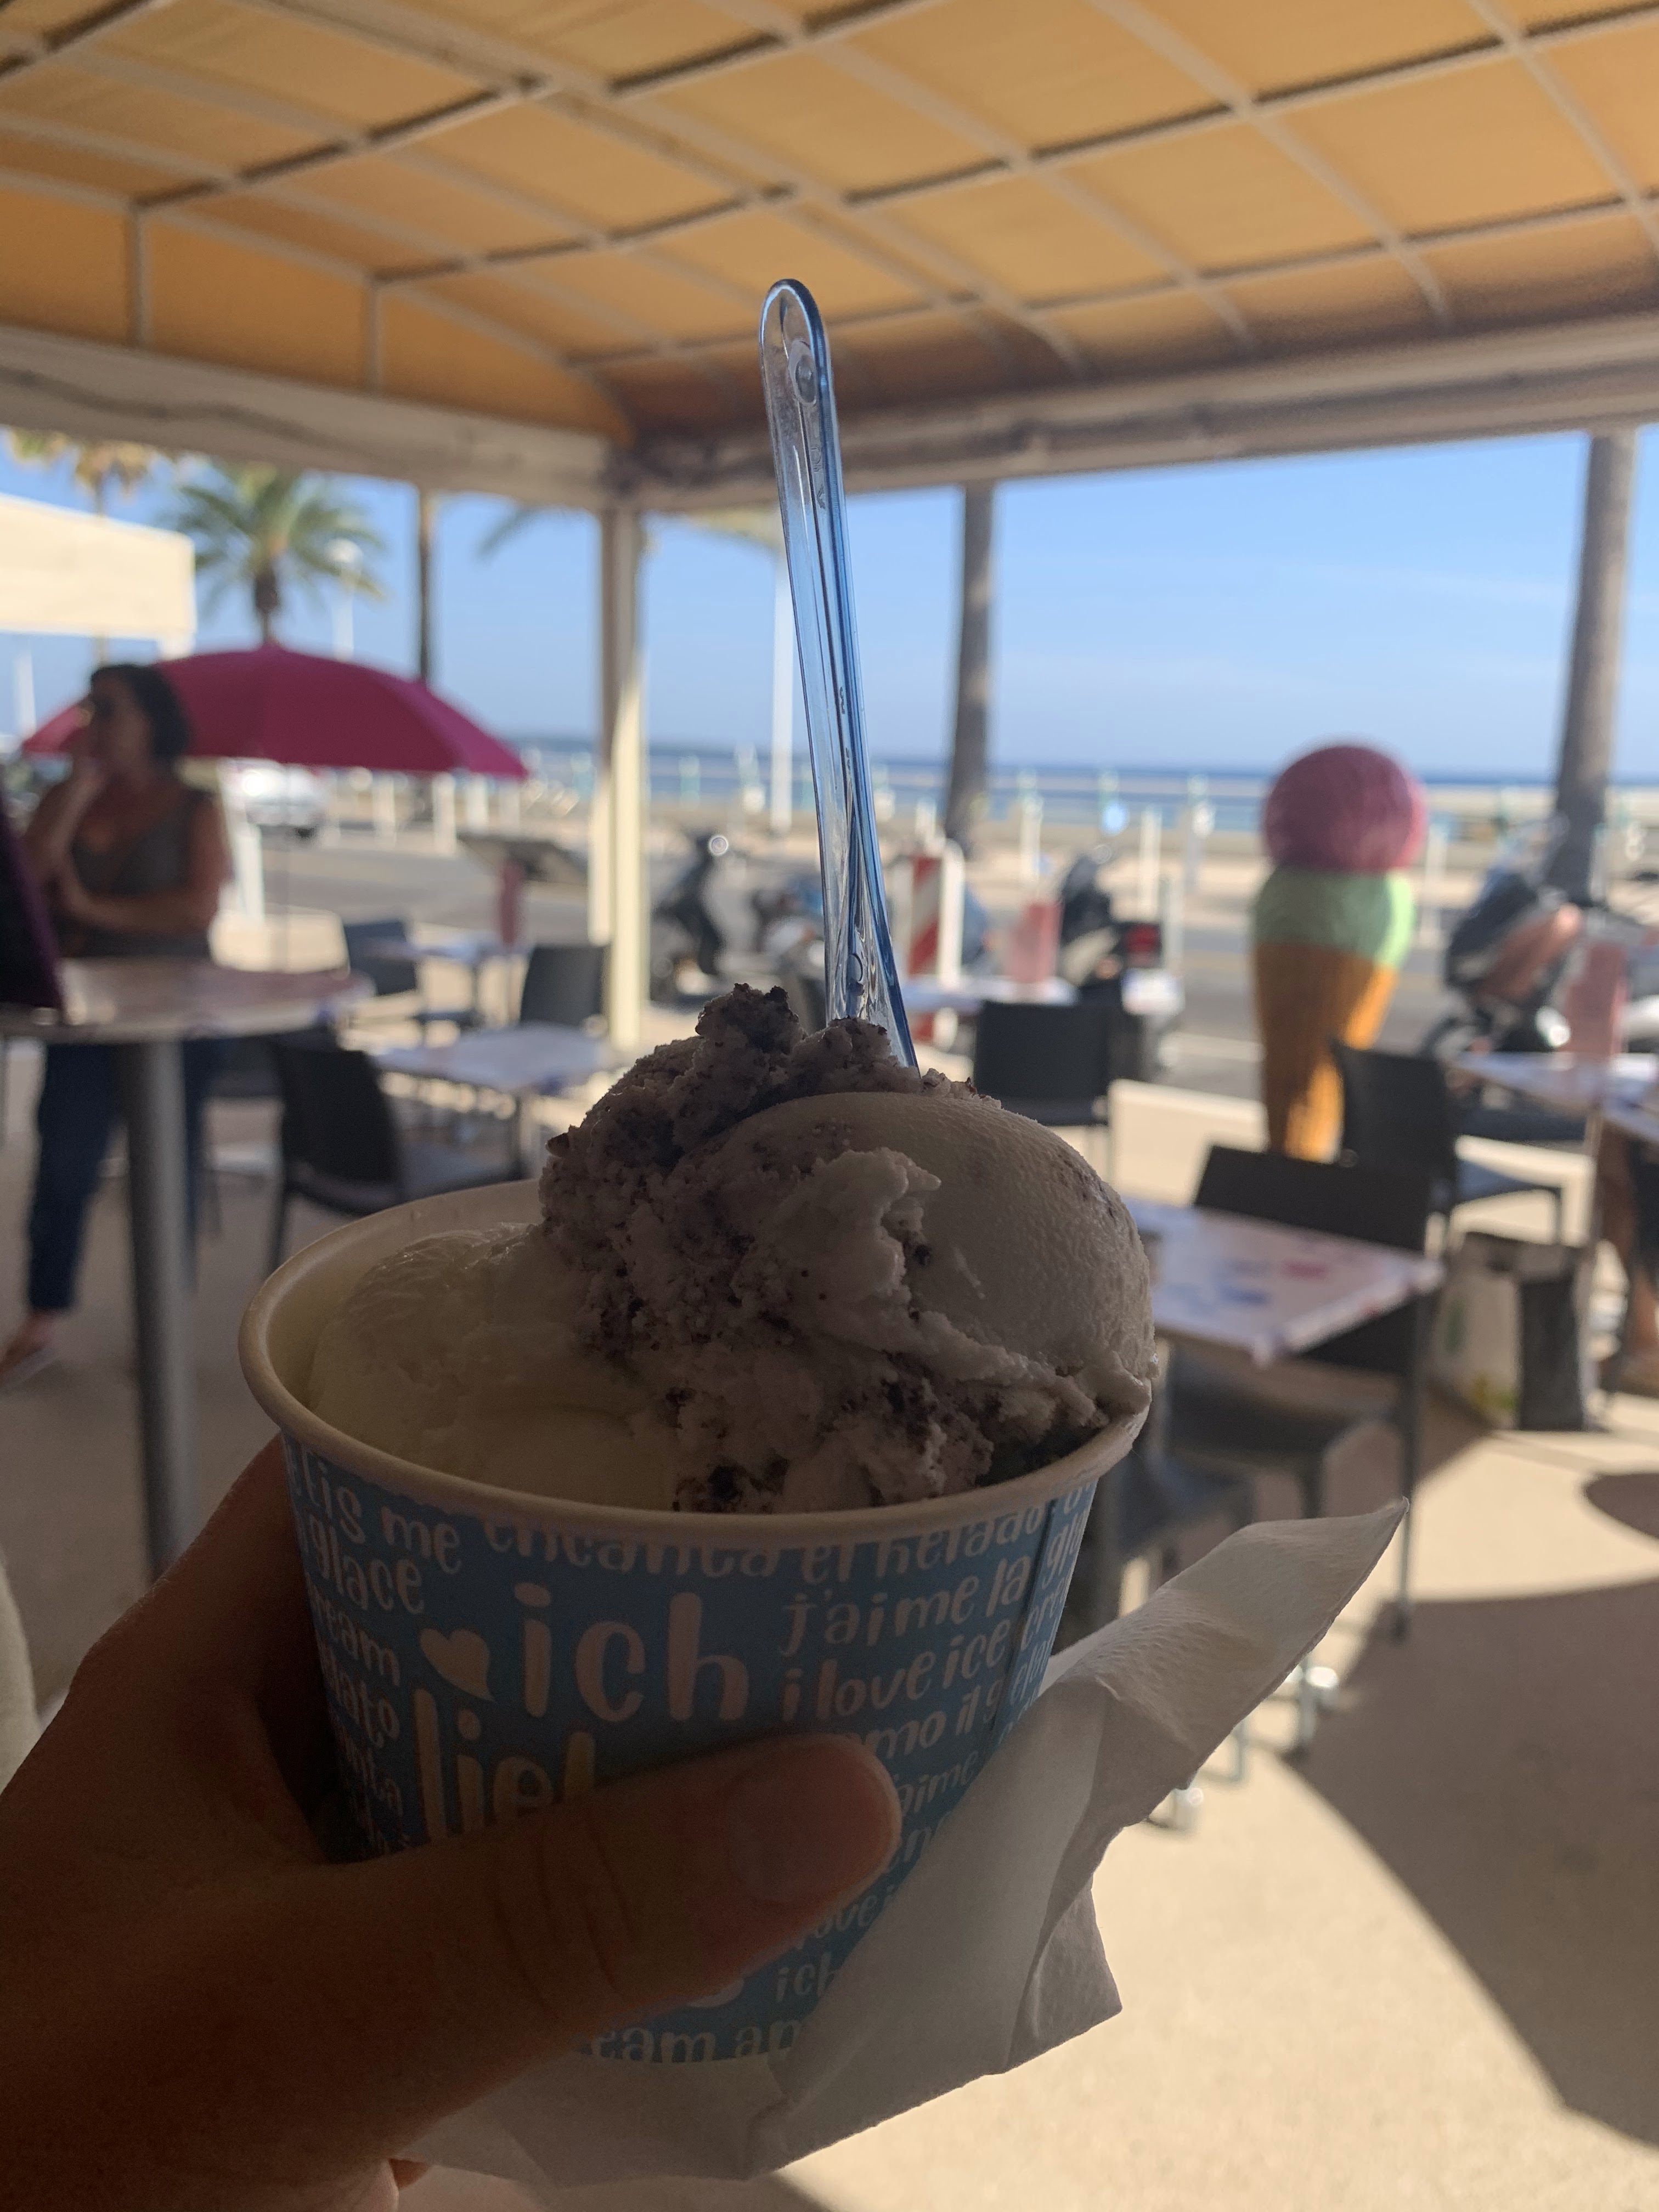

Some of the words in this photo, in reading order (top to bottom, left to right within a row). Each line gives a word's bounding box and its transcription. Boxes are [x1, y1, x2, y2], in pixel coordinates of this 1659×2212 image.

[309, 1513, 425, 1615] glace
[380, 1505, 461, 1575] me
[514, 1582, 749, 1723] ich
[778, 1576, 979, 1657] j'aime
[986, 1555, 1032, 1618] la
[780, 1668, 805, 1724] i
[815, 1650, 936, 1721] love
[941, 1618, 1011, 1688] ice
[864, 1711, 947, 1760] mo
[955, 1688, 979, 1735] il
